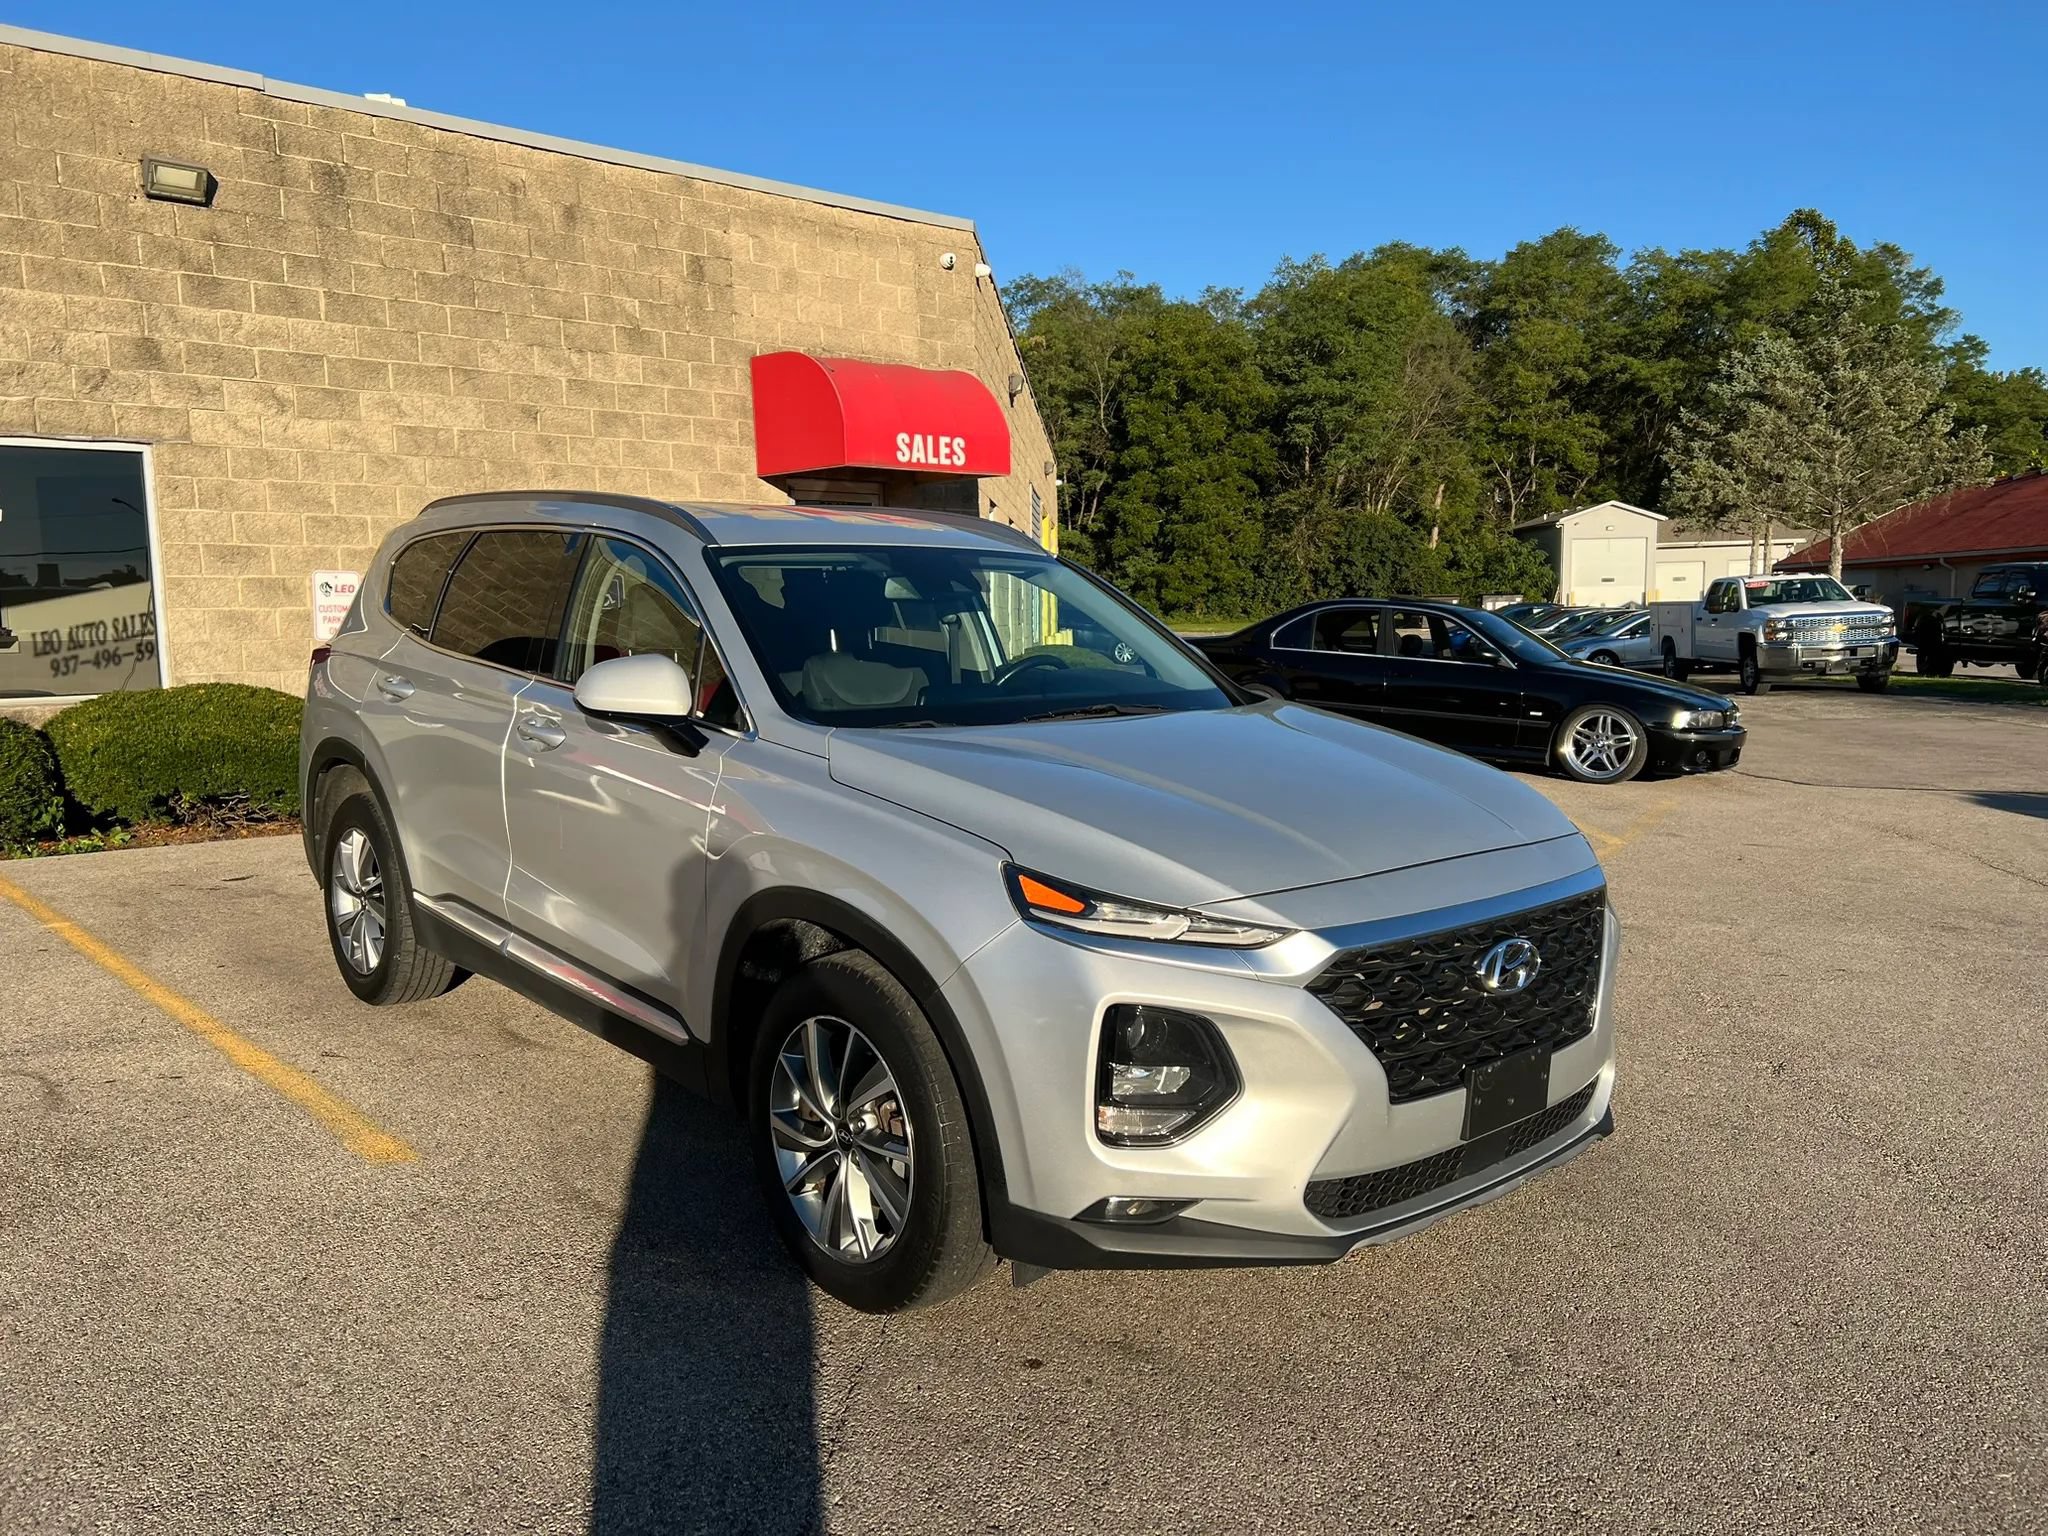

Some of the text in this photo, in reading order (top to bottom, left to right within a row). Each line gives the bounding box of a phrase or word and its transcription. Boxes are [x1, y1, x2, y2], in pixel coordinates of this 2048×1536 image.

[896, 432, 966, 466] SALES
[334, 583, 355, 593] LEO
[318, 604, 350, 613] CUSTOM
[322, 616, 344, 625] PARK
[31, 611, 155, 657] LEO AUTO SALES
